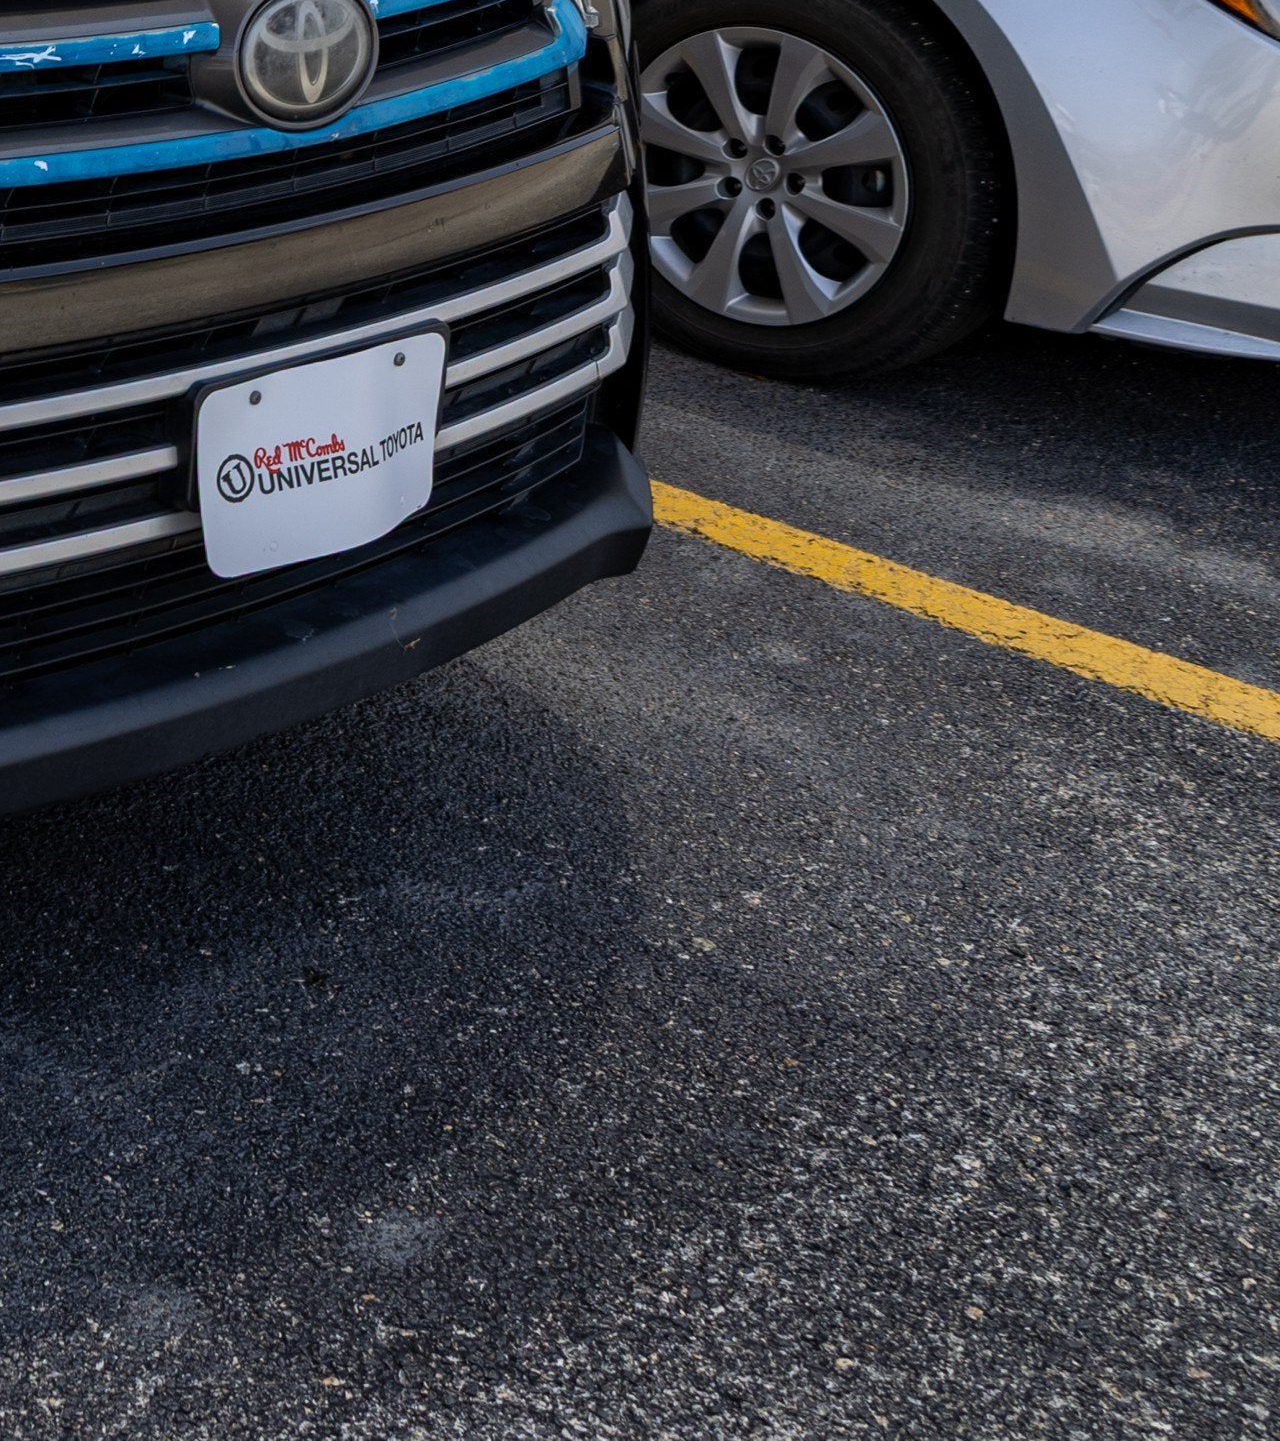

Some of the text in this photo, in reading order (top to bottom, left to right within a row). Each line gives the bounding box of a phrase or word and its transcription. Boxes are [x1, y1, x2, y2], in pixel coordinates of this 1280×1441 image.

[254, 434, 346, 474] Red McCombs
[258, 422, 424, 495] UNIVERSAL TOYOTA
